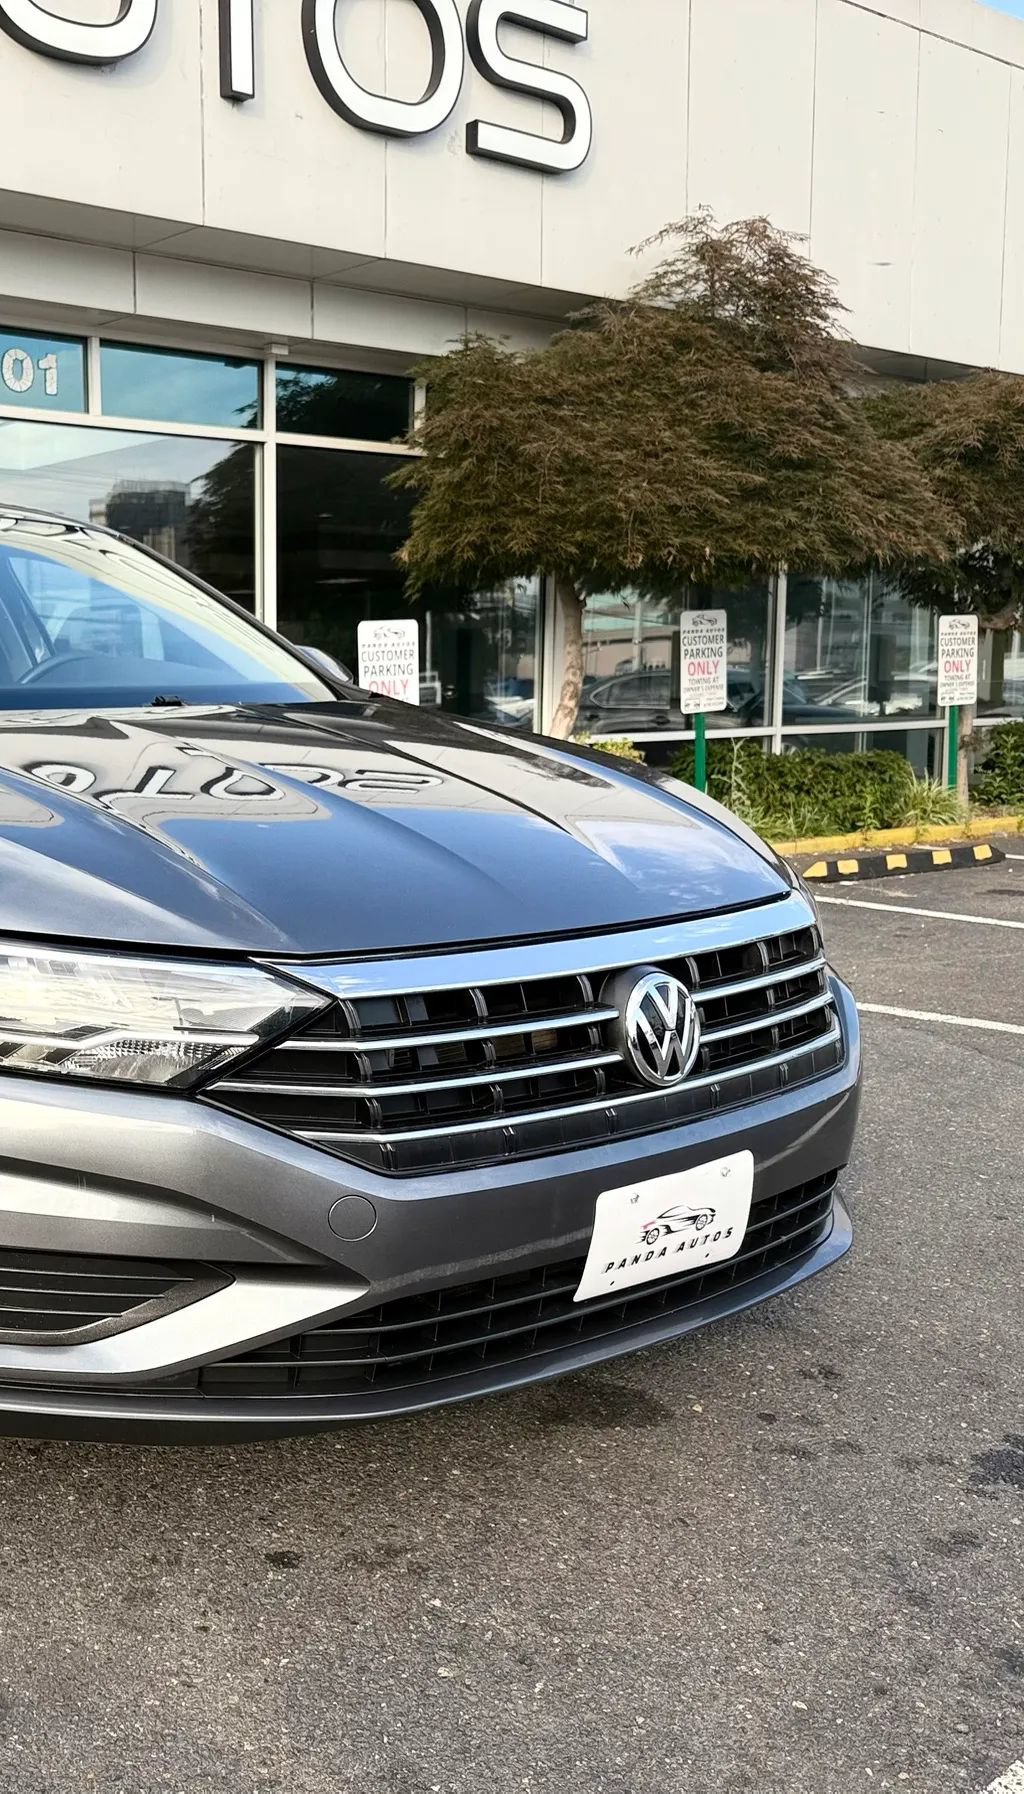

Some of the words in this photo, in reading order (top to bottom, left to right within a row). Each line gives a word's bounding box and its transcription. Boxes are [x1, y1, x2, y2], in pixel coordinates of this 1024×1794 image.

[682, 634, 724, 646] CUSTOMER
[940, 637, 975, 647] CUSTOMER
[361, 649, 415, 662] CUSTOMER
[684, 646, 723, 659] PARKING
[941, 648, 975, 659] PARKING
[363, 663, 414, 677] PARKING
[687, 660, 719, 676] ONLY
[944, 659, 972, 674] ONLY
[368, 679, 409, 696] ONLY
[605, 1246, 668, 1273] PANDA
[676, 1226, 734, 1253] AUTOS
